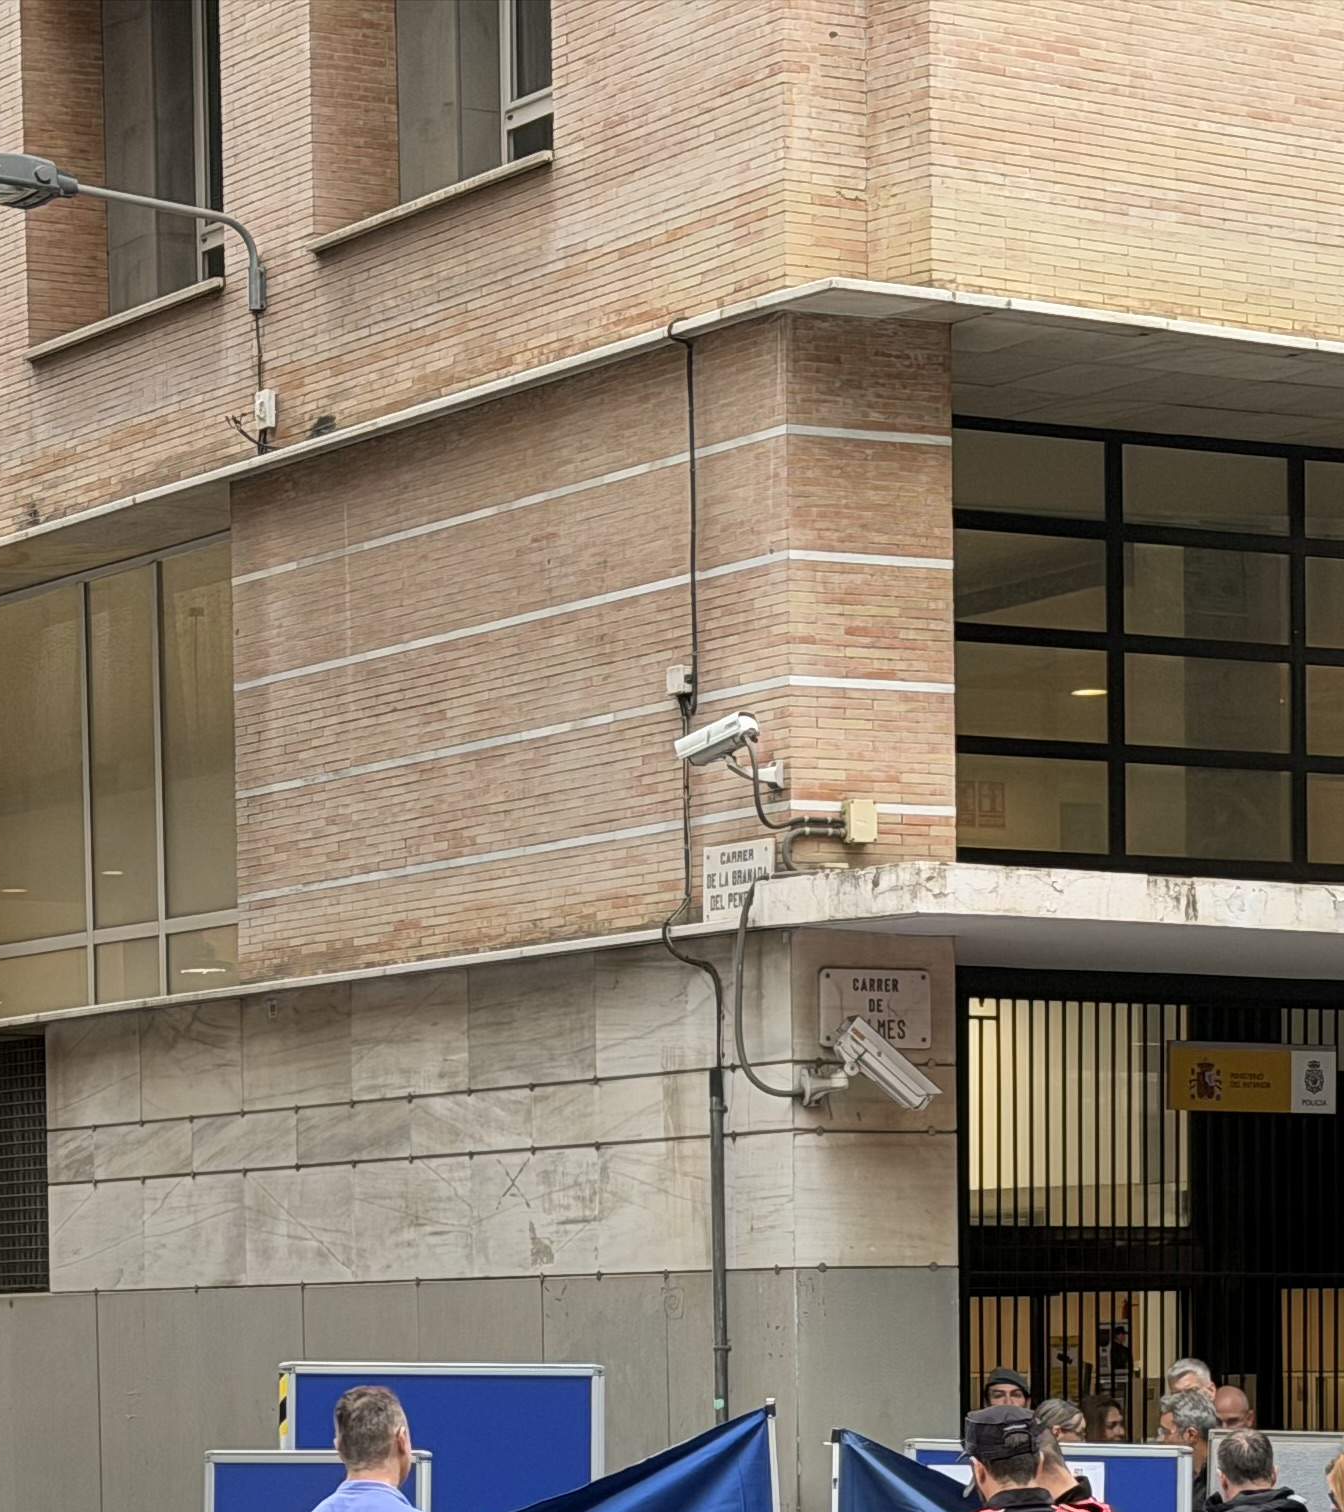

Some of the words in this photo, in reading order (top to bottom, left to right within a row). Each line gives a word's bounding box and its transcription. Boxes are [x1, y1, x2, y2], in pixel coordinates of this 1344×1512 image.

[720, 848, 754, 865] CARRER
[706, 873, 717, 889] DE
[719, 871, 729, 887] LA
[710, 894, 725, 911] DEL
[852, 977, 899, 992] CARRER
[868, 998, 884, 1013] DE
